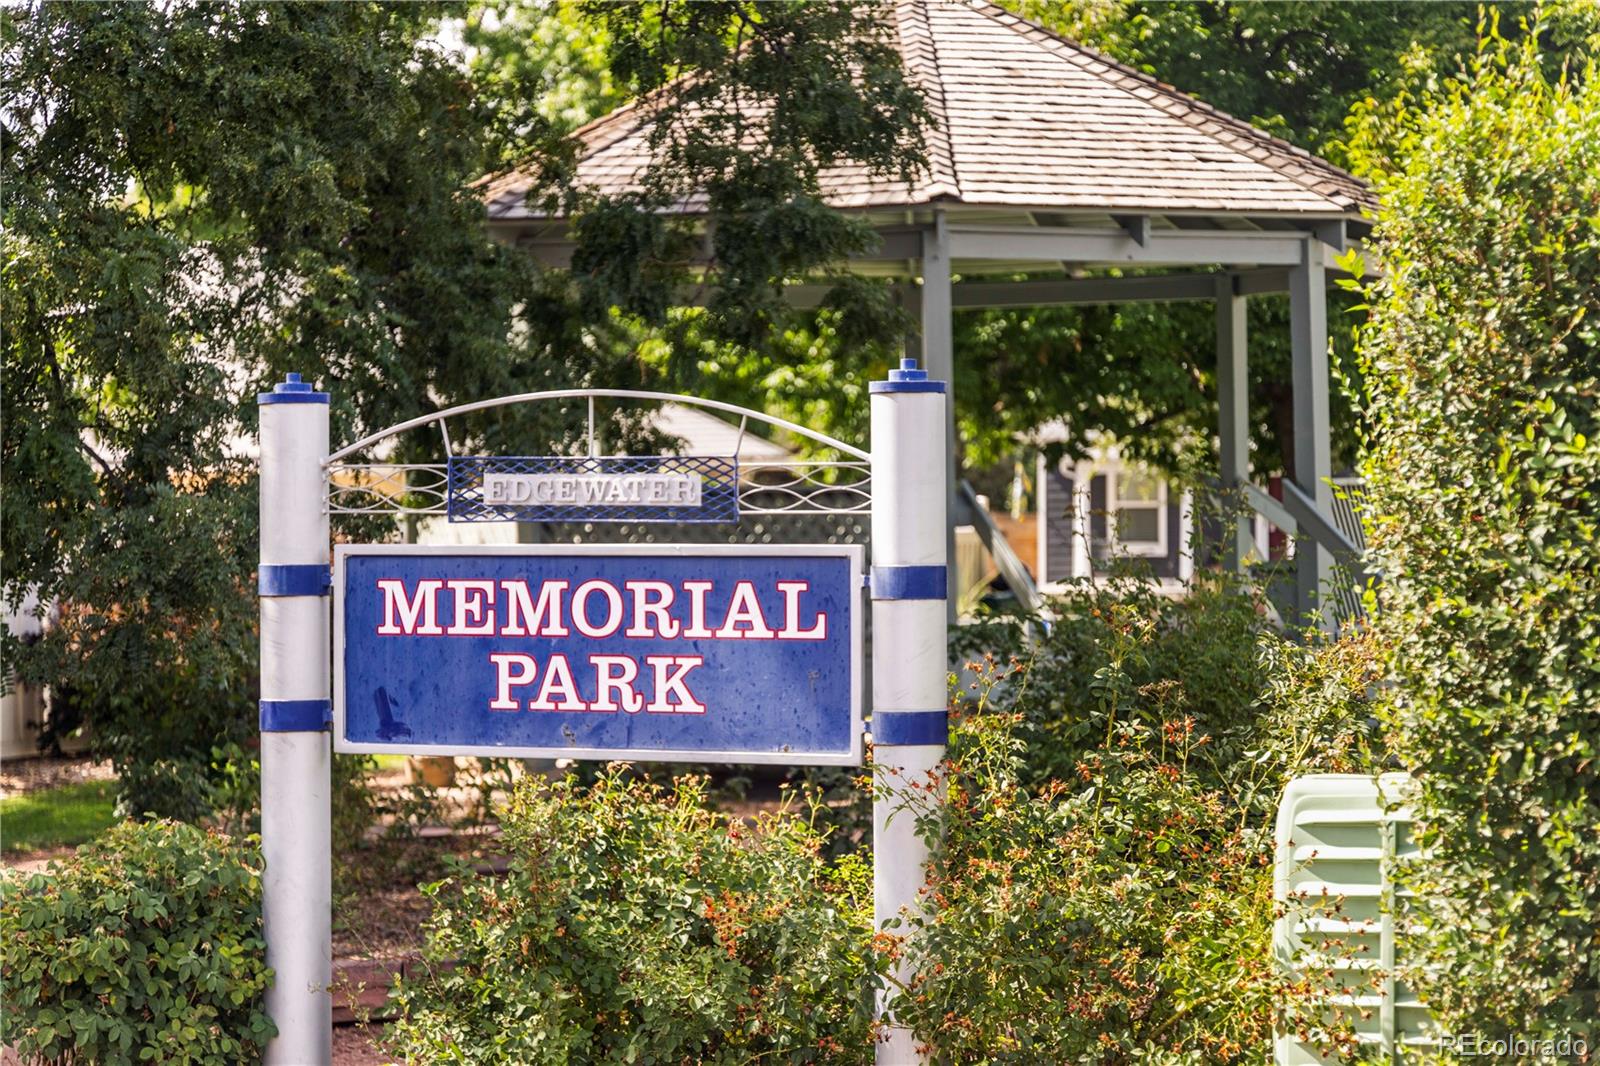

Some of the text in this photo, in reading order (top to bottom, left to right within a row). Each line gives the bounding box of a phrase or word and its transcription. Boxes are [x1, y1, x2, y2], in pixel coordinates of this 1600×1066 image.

[490, 477, 697, 503] EDGEWATER
[376, 579, 827, 640] MEMORIAL
[489, 653, 706, 714] PARK
